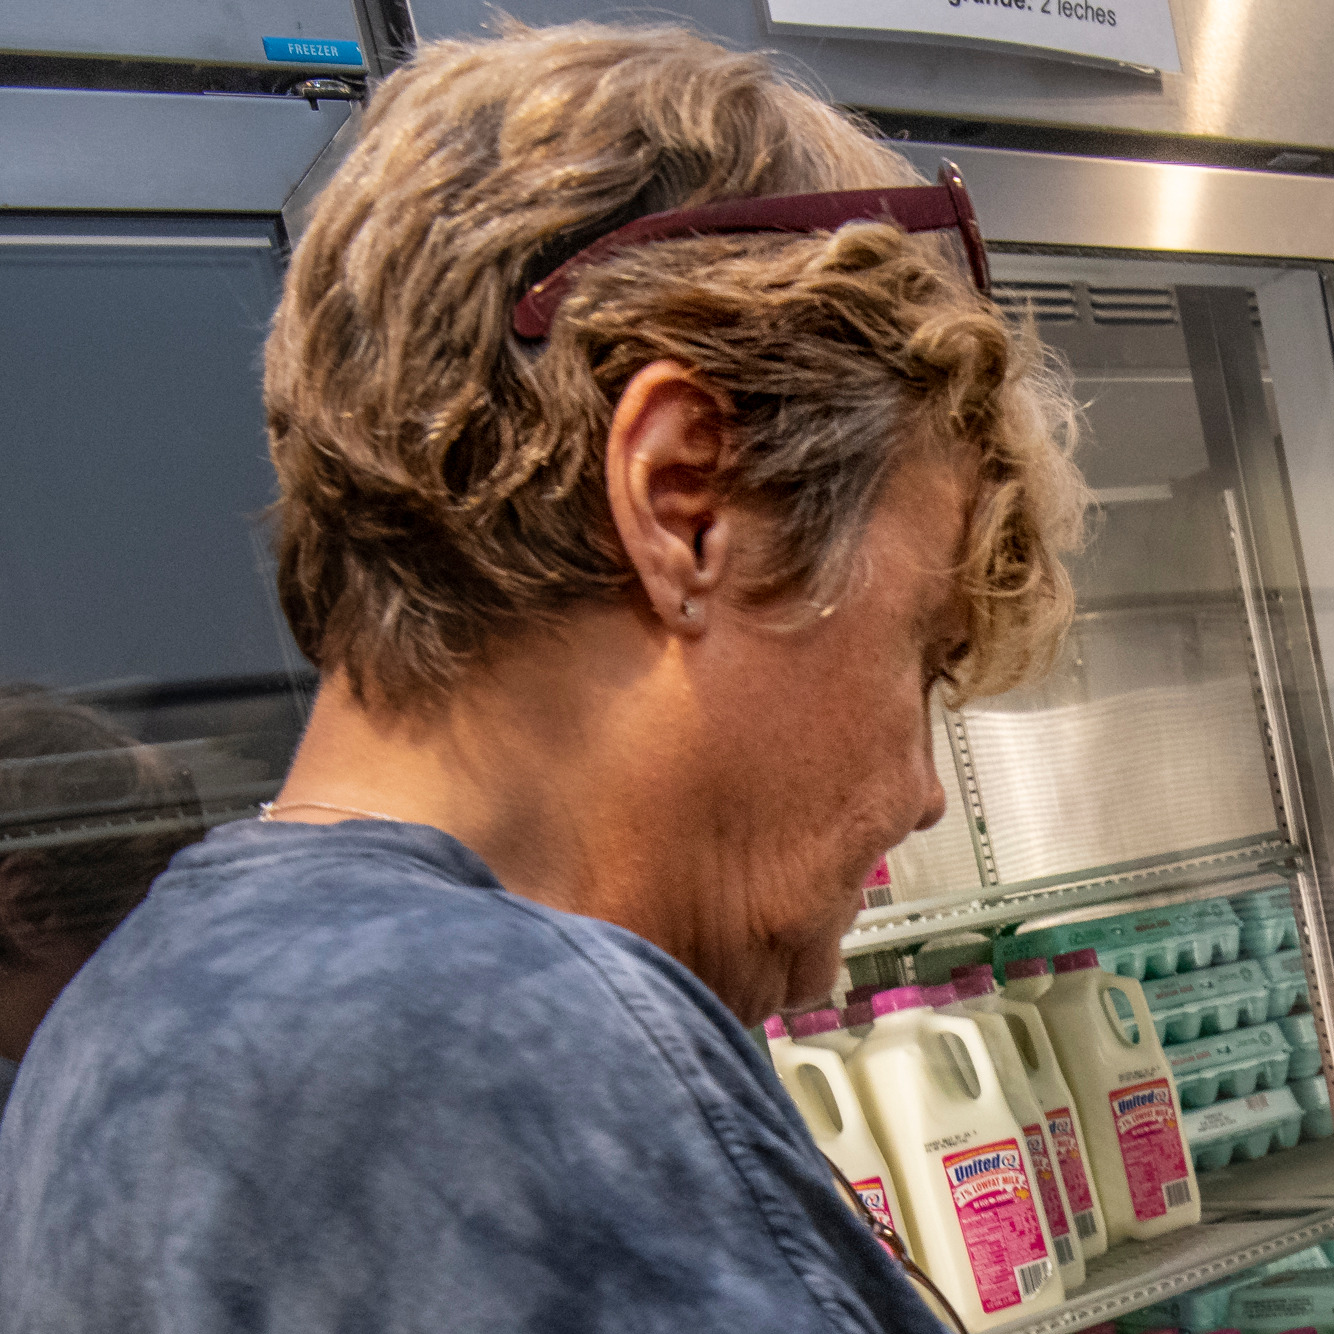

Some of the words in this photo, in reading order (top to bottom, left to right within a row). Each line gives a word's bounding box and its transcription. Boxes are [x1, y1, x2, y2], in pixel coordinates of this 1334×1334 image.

[1057, 0, 1118, 27] leches
[287, 43, 339, 57] FREEZER
[954, 1153, 1001, 1183] United
